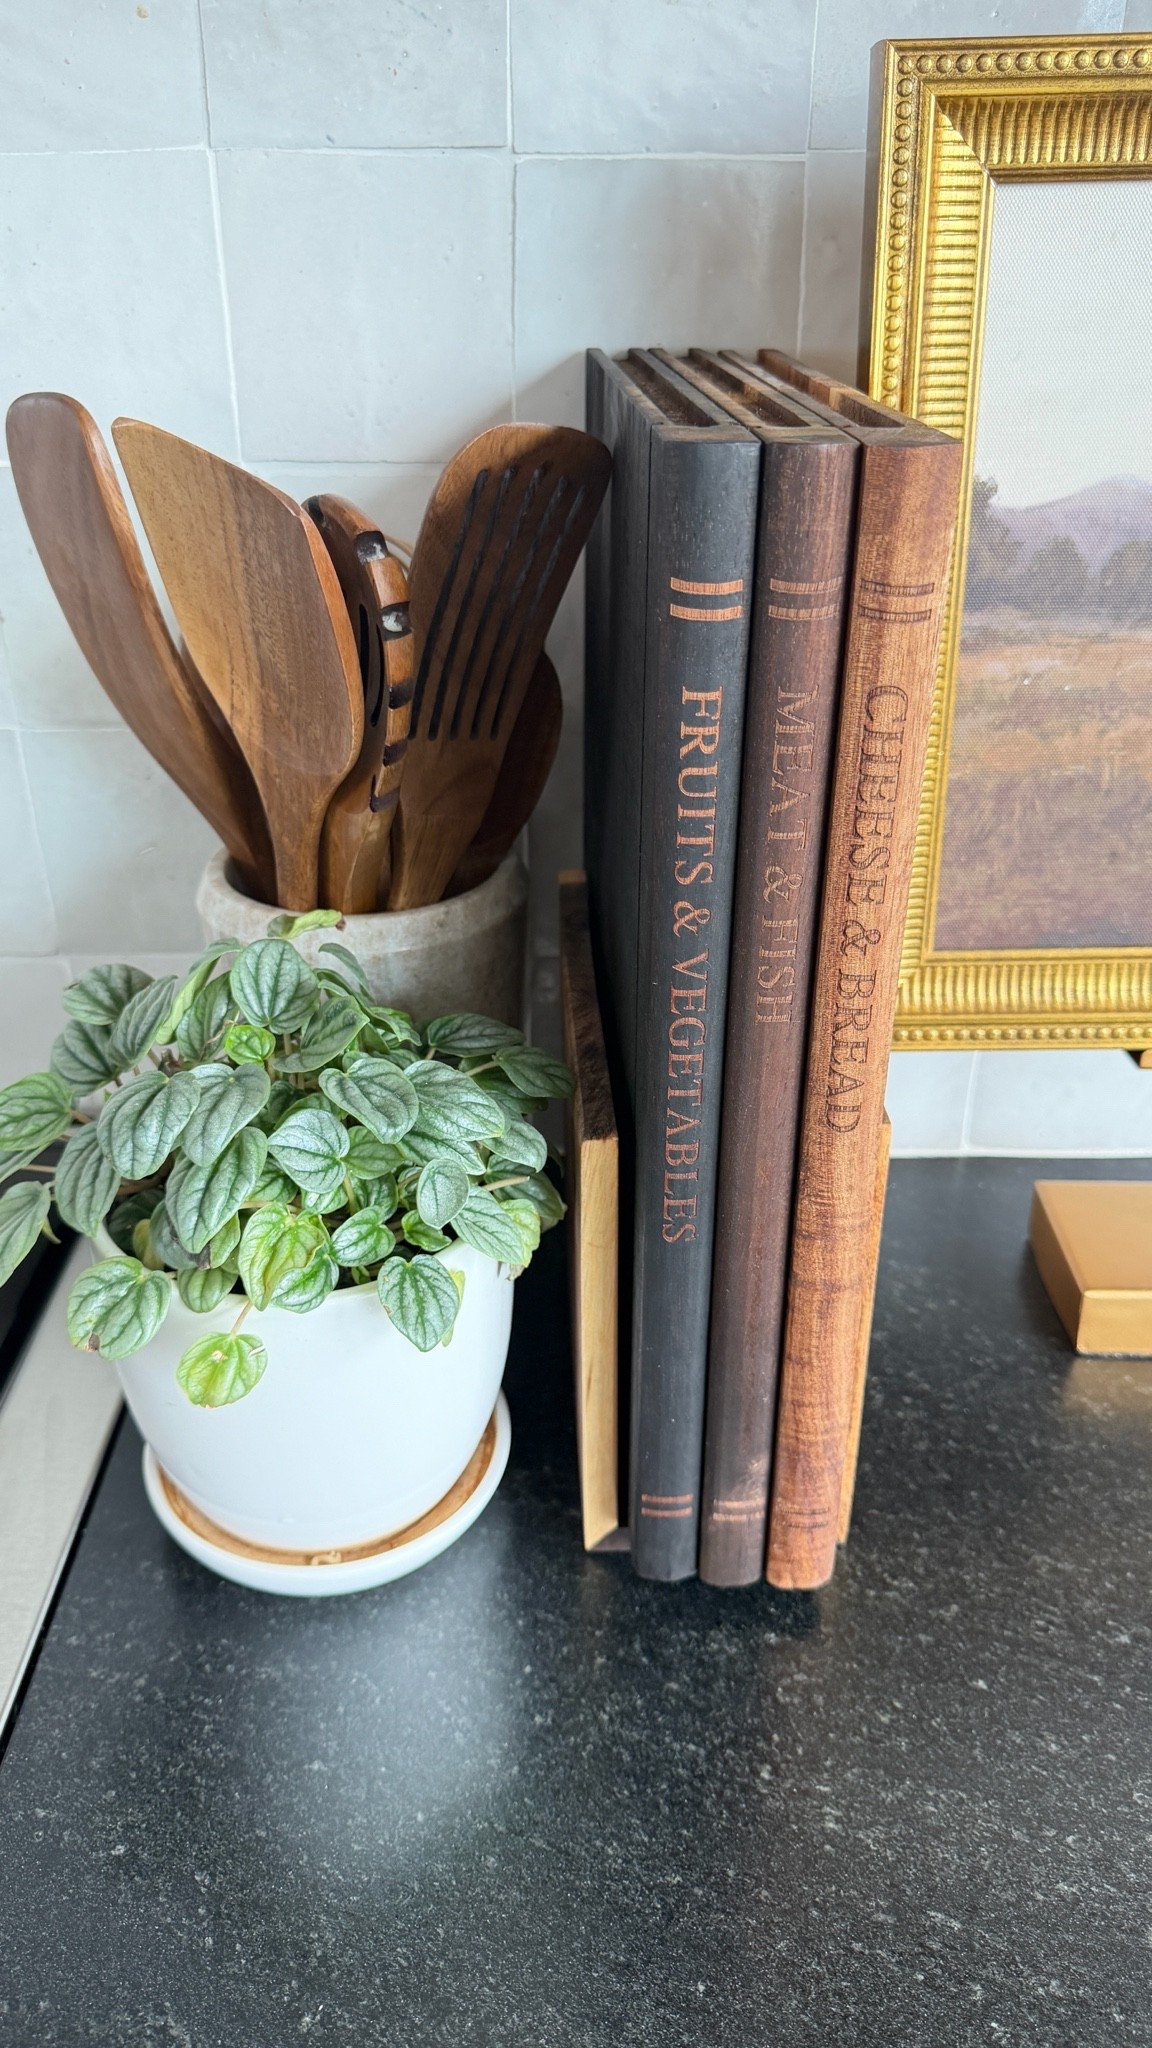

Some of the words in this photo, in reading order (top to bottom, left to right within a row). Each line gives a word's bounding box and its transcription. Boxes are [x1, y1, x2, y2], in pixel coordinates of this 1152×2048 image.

[673, 686, 723, 885] FRUITS
[766, 684, 819, 852] MEAT
[845, 685, 909, 906] CHEESE
[672, 901, 712, 938] &
[763, 865, 803, 903] &
[842, 919, 882, 957] &
[756, 915, 799, 1025] FISH
[825, 969, 879, 1134] BREAD
[662, 949, 711, 1244] VEGETABLES
